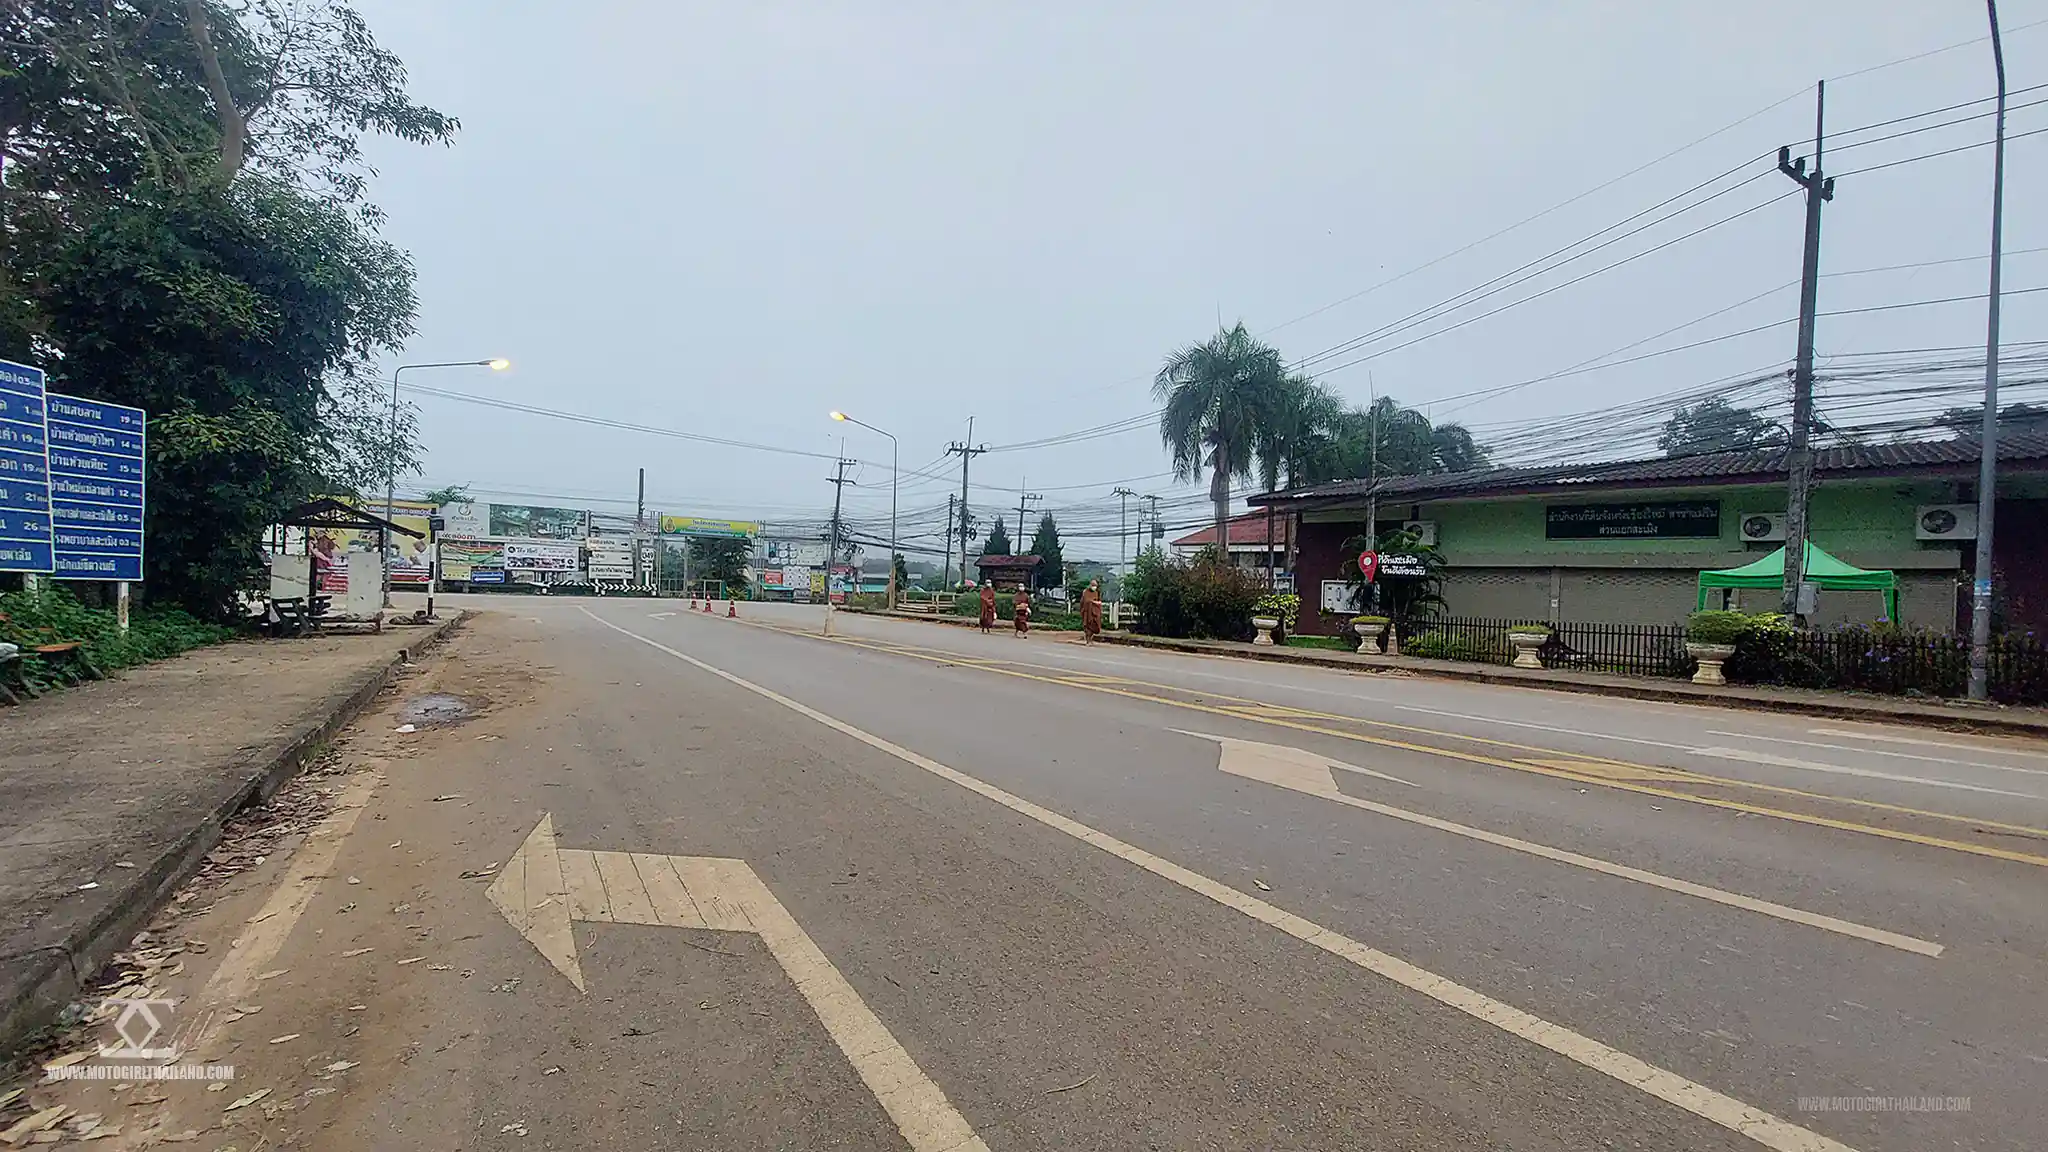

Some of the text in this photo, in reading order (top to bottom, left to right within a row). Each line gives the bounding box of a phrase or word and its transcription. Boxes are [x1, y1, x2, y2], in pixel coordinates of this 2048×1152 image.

[24, 521, 39, 531] 26
[54, 534, 118, 547] รงพยาบาลสะเมิง
